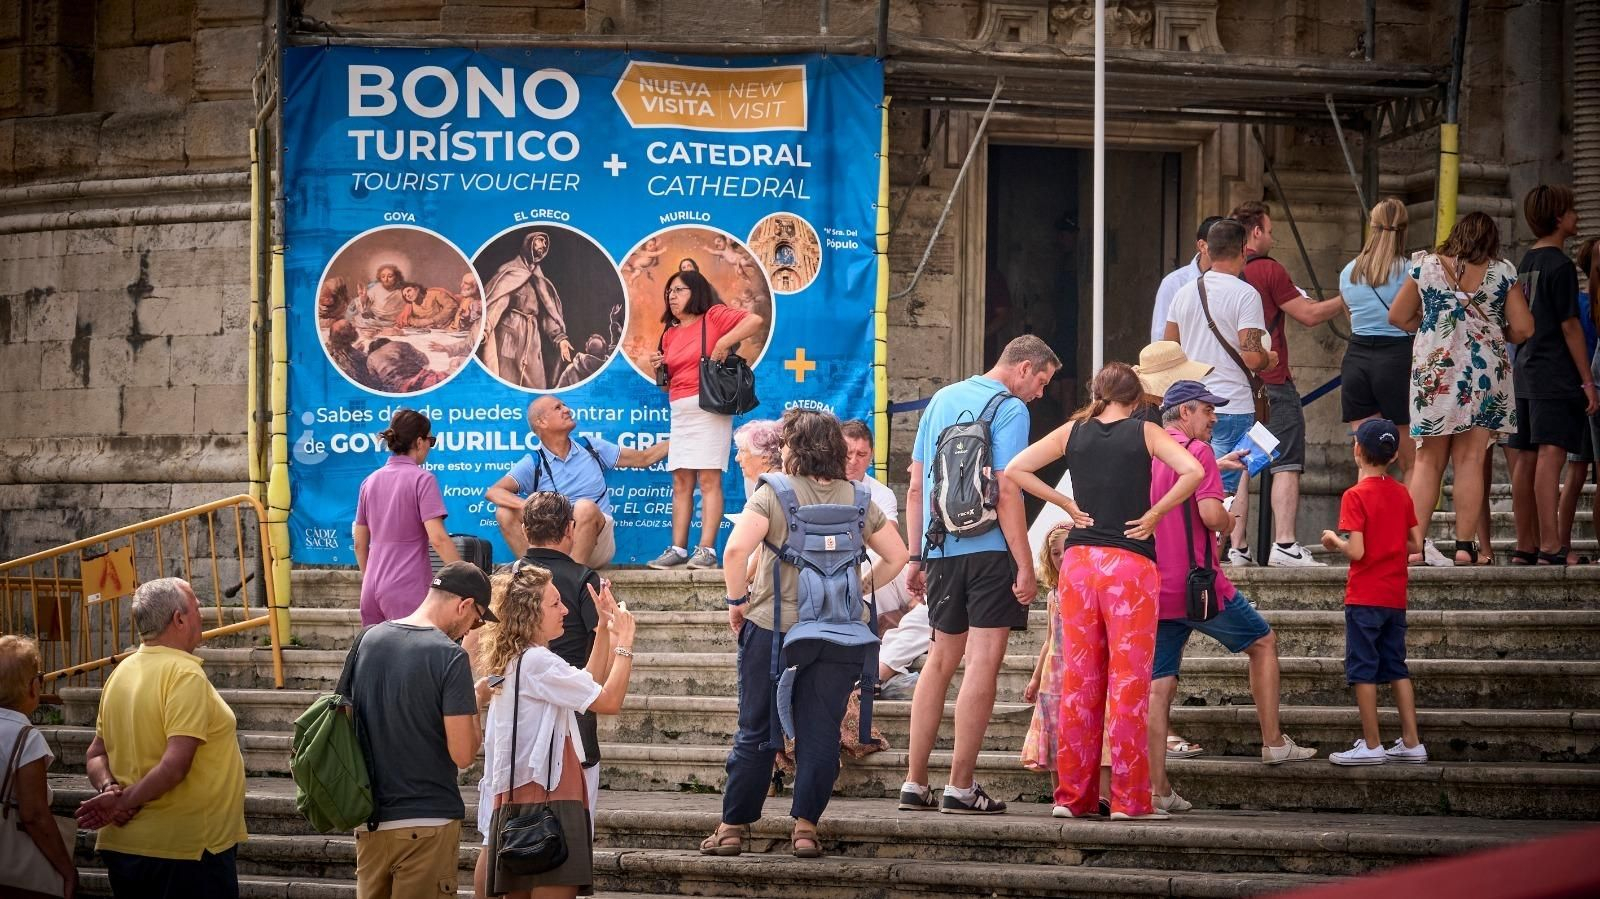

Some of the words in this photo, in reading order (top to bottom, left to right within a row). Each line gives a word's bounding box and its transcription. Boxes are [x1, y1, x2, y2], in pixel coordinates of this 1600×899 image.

[348, 65, 580, 119] BONO
[639, 78, 711, 97] NUEVA
[729, 82, 783, 98] NEW
[641, 96, 715, 116] VISITA
[729, 101, 786, 119] VISIT
[348, 123, 580, 161] TURÍSTICO
[646, 142, 811, 167] CATEDRAL
[352, 173, 454, 191] TOURIST
[460, 173, 580, 191] VOUCHER
[648, 176, 810, 199] CATHEDRAL
[384, 212, 415, 222] GOYA
[514, 212, 528, 222] EL
[531, 209, 570, 221] GRECO
[660, 211, 711, 224] MURILLO
[317, 406, 373, 422] Sabes
[379, 403, 443, 421] dde
[449, 403, 522, 424] puedes
[570, 406, 624, 421] ontrar
[304, 438, 325, 453] de
[331, 432, 391, 453] GOY
[447, 462, 472, 471] esto
[474, 463, 481, 472] y
[444, 484, 484, 497] know
[469, 501, 485, 513] of
[623, 502, 641, 514] EL
[644, 502, 673, 514] GRE
[305, 537, 339, 549] SACRA
